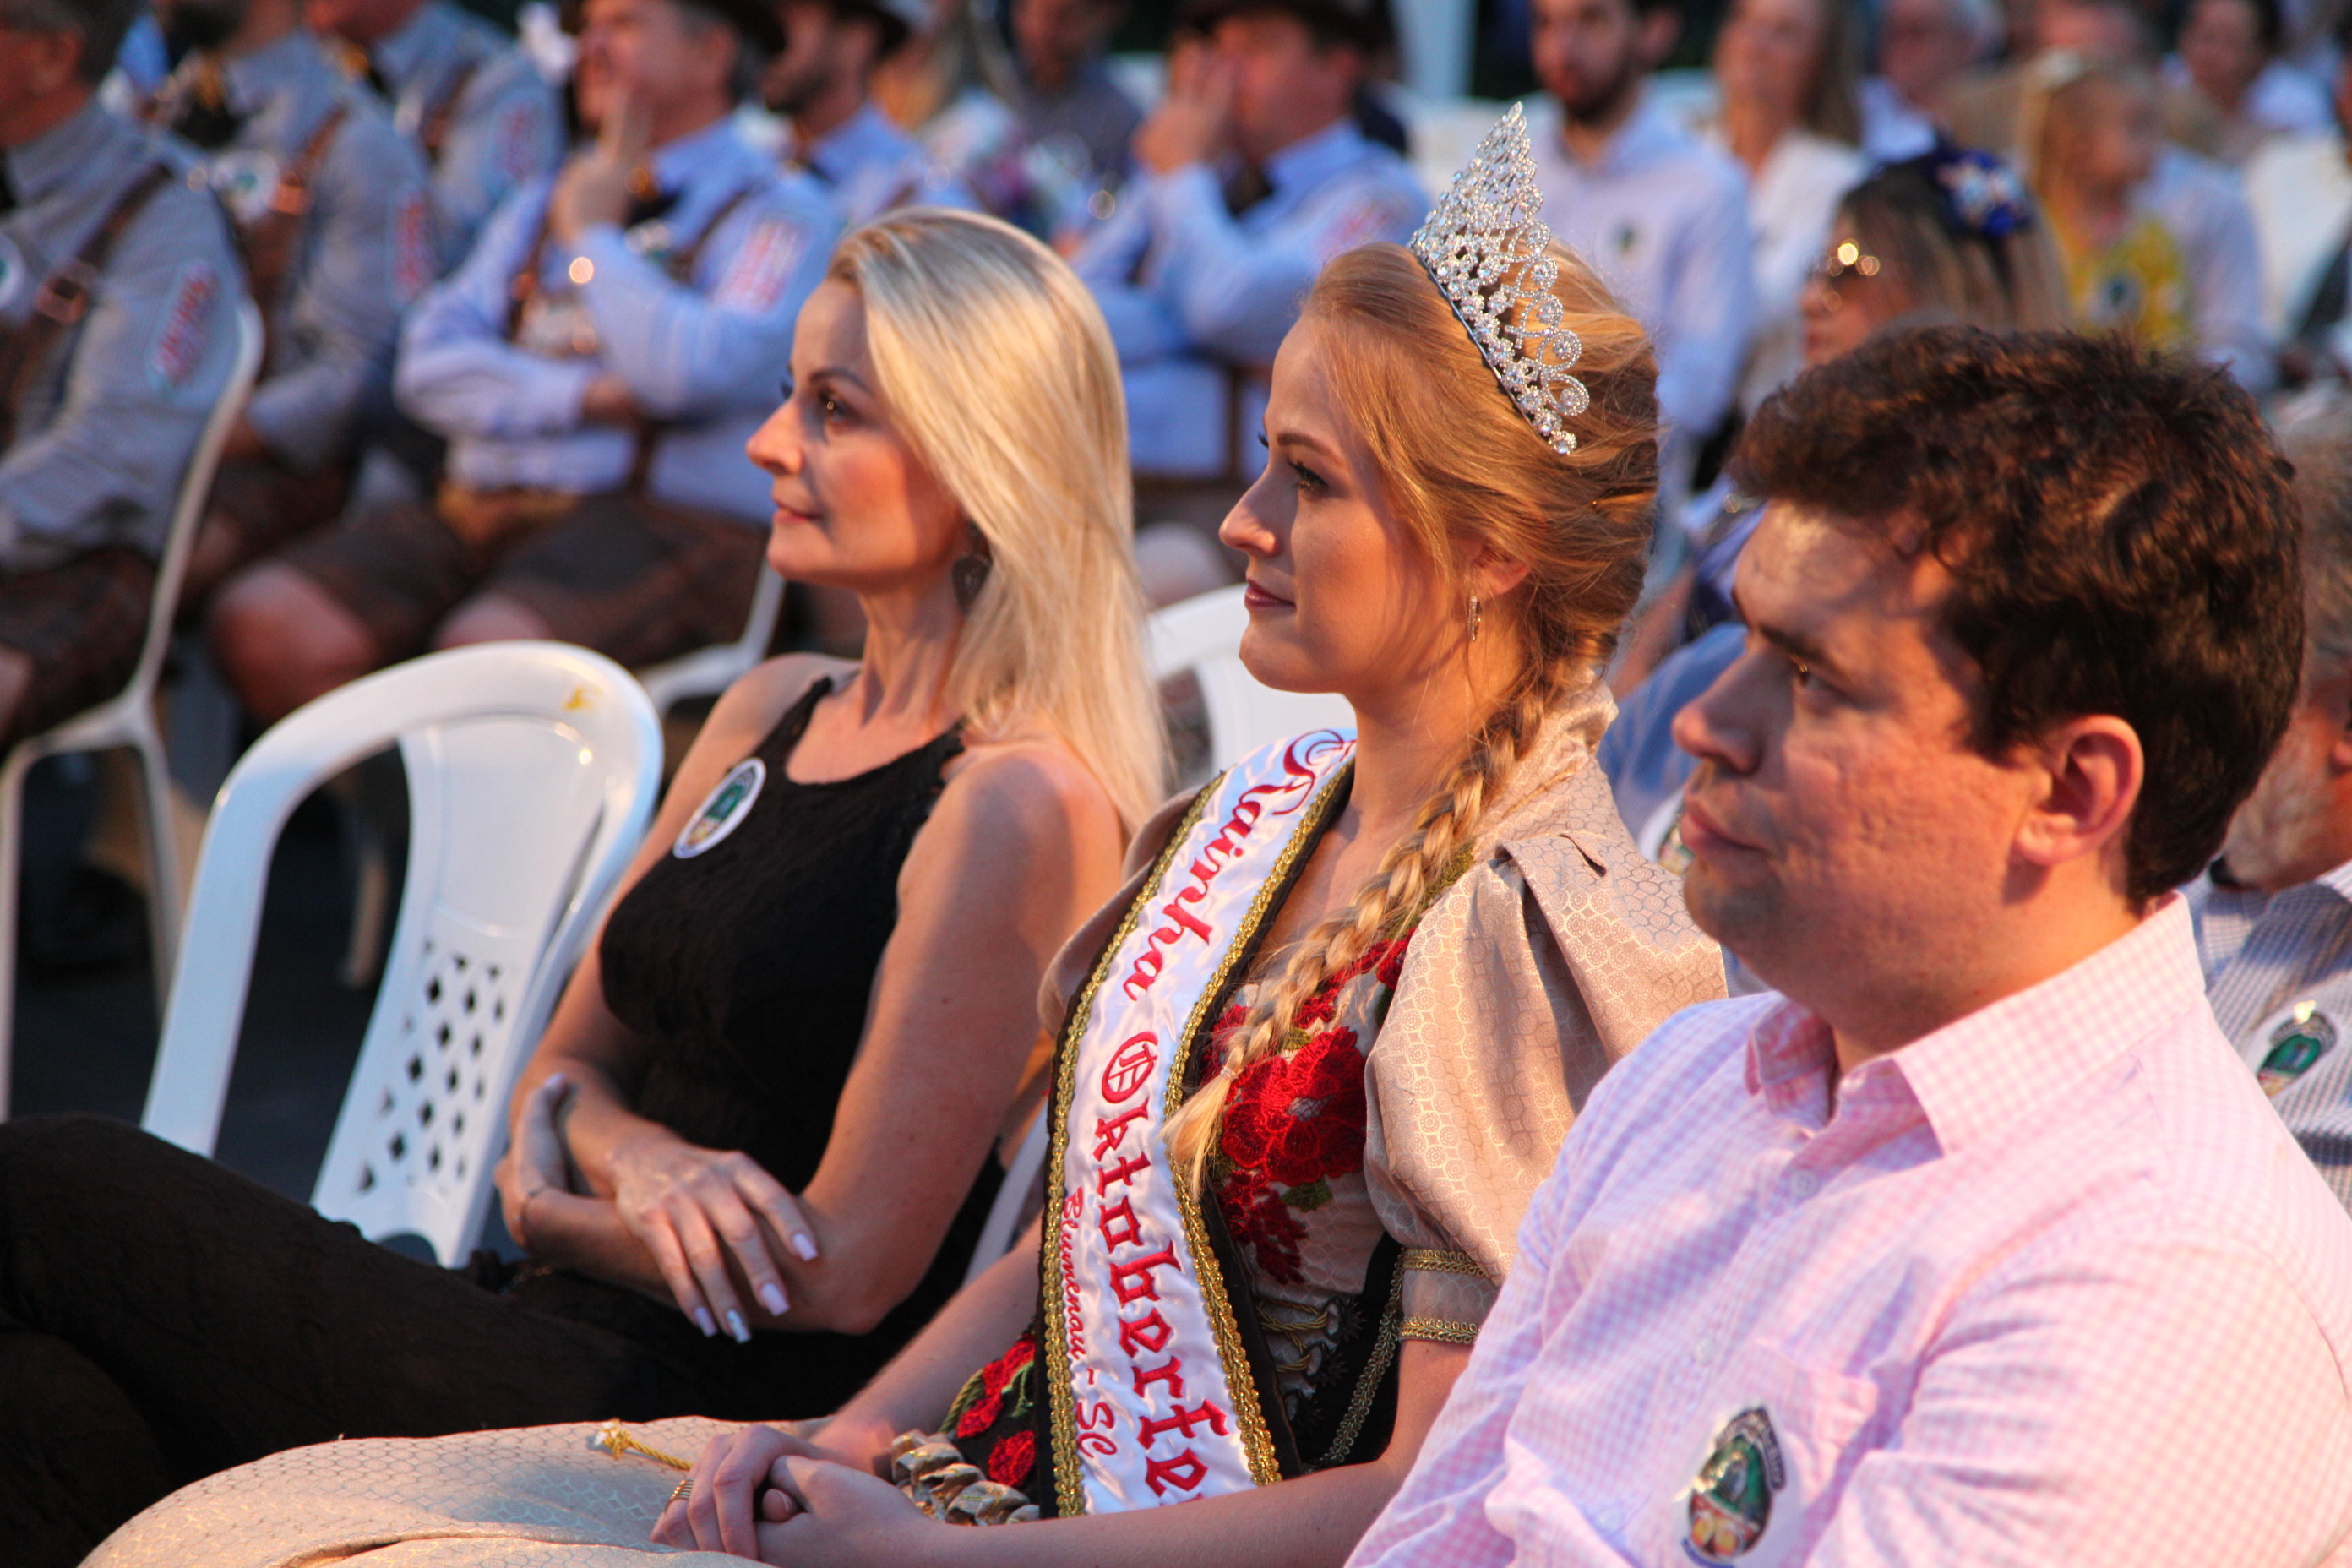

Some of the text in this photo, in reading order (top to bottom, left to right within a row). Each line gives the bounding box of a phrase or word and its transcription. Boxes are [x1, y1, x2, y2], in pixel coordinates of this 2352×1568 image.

[1059, 1185, 1092, 1360] Blumenau
[1093, 1030, 1230, 1507] Oktoberfe
[1075, 1401, 1118, 1461] SC
